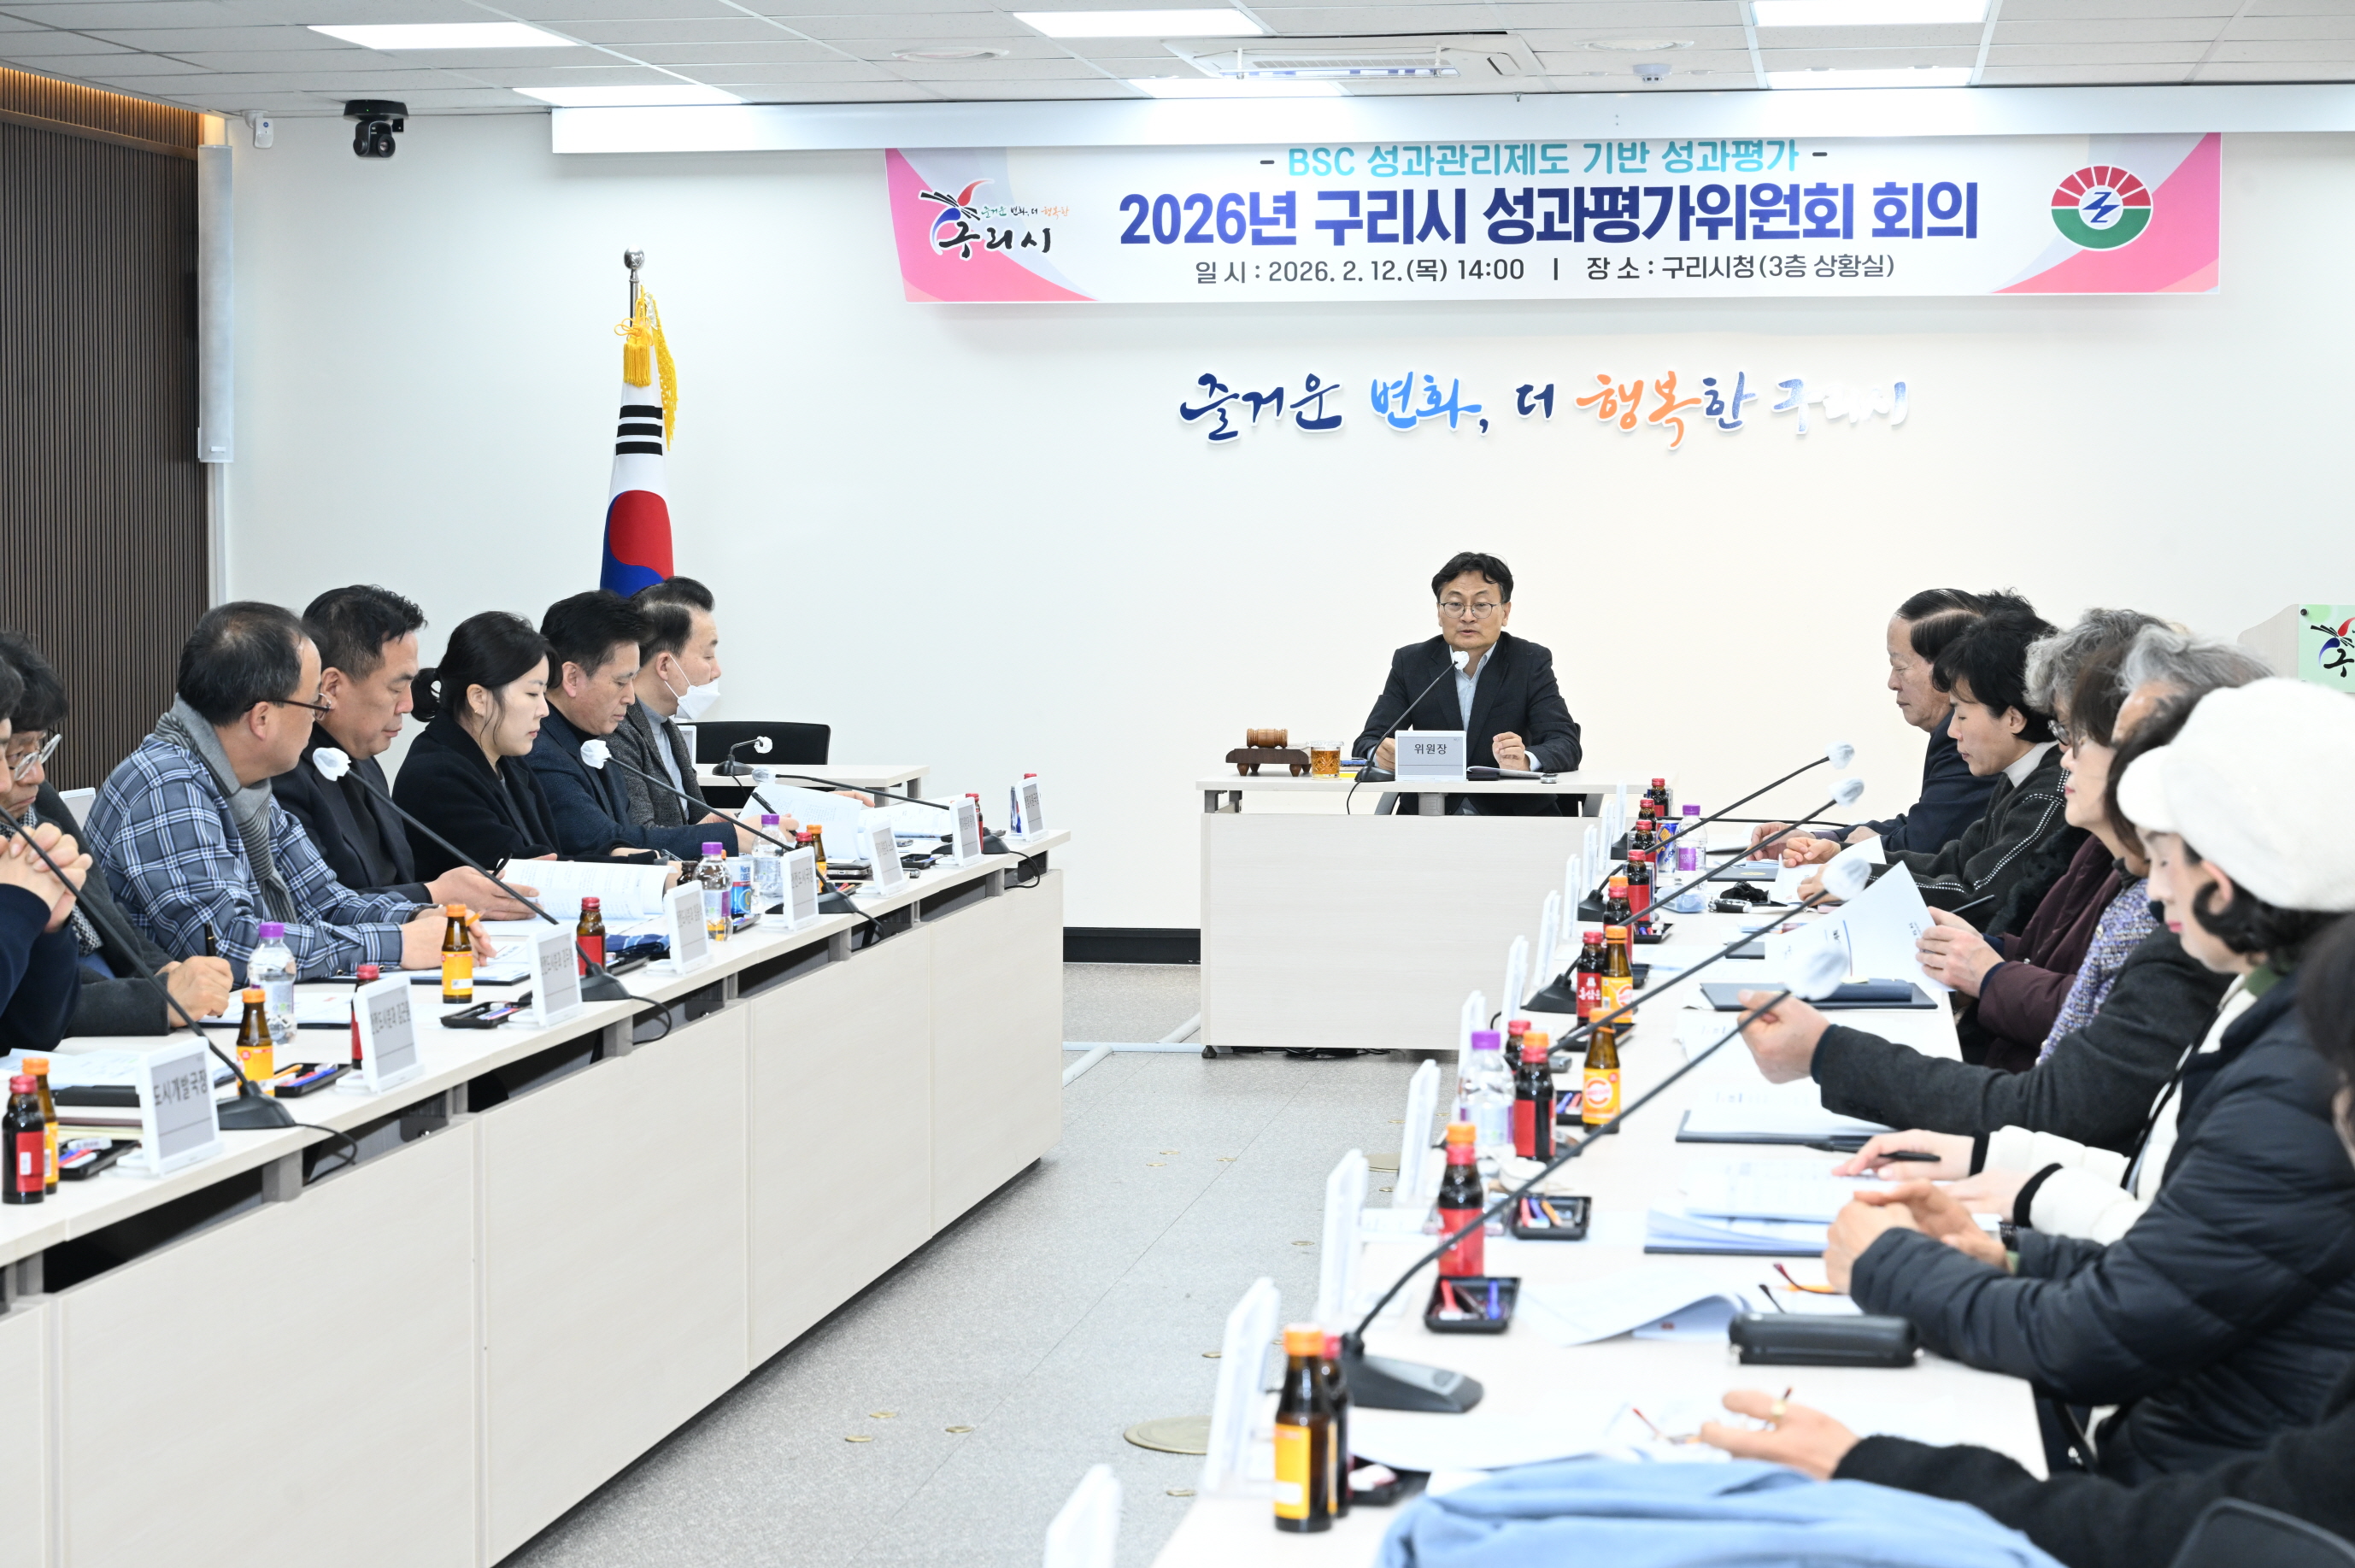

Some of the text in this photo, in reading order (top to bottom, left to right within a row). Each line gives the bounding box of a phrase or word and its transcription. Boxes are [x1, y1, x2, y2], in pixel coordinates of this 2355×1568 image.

[1288, 146, 1355, 176] BSC
[1367, 143, 1569, 177] 성과관리제도
[1583, 141, 1650, 174] 기반
[1661, 138, 1799, 173] 성과평가
[981, 206, 1007, 218] 즐거운
[1041, 206, 1070, 220] 행복한
[1119, 182, 1977, 246] 2026년 구리시 성과평가위원회 회의
[938, 221, 1051, 259] 구리시
[1270, 261, 1335, 282] 2026.
[1343, 261, 1363, 281] 2.
[1459, 259, 1524, 279] 14:00
[1814, 254, 1894, 277] 상황실)
[1180, 373, 1342, 441] 즐거운
[1371, 372, 1489, 433] 변화,
[1516, 384, 1553, 418] 더
[1577, 371, 1755, 447] 행복한
[1414, 743, 1447, 755] 위원장
[154, 1069, 208, 1106] 도시개발국장
